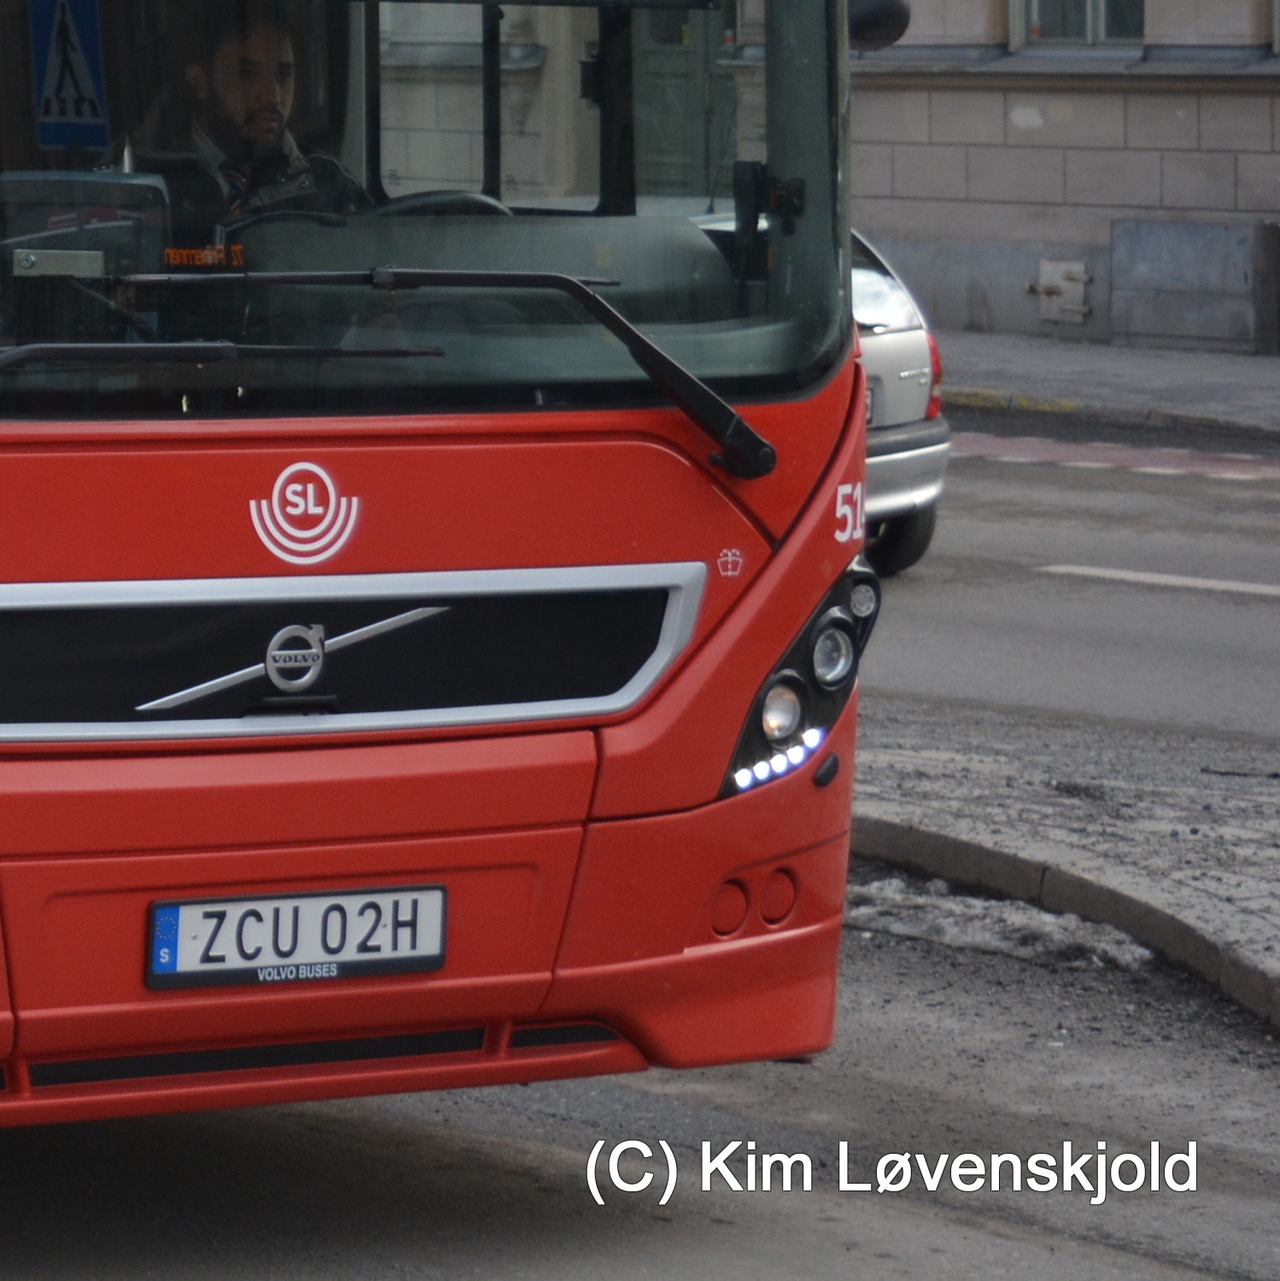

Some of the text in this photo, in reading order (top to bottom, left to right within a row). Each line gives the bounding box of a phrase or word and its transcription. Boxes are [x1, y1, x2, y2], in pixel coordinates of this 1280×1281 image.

[284, 482, 324, 516] SL
[271, 653, 320, 664] VOLVO
[199, 897, 419, 964] ZCU 02H
[257, 963, 337, 981] VOLVO BUSES
